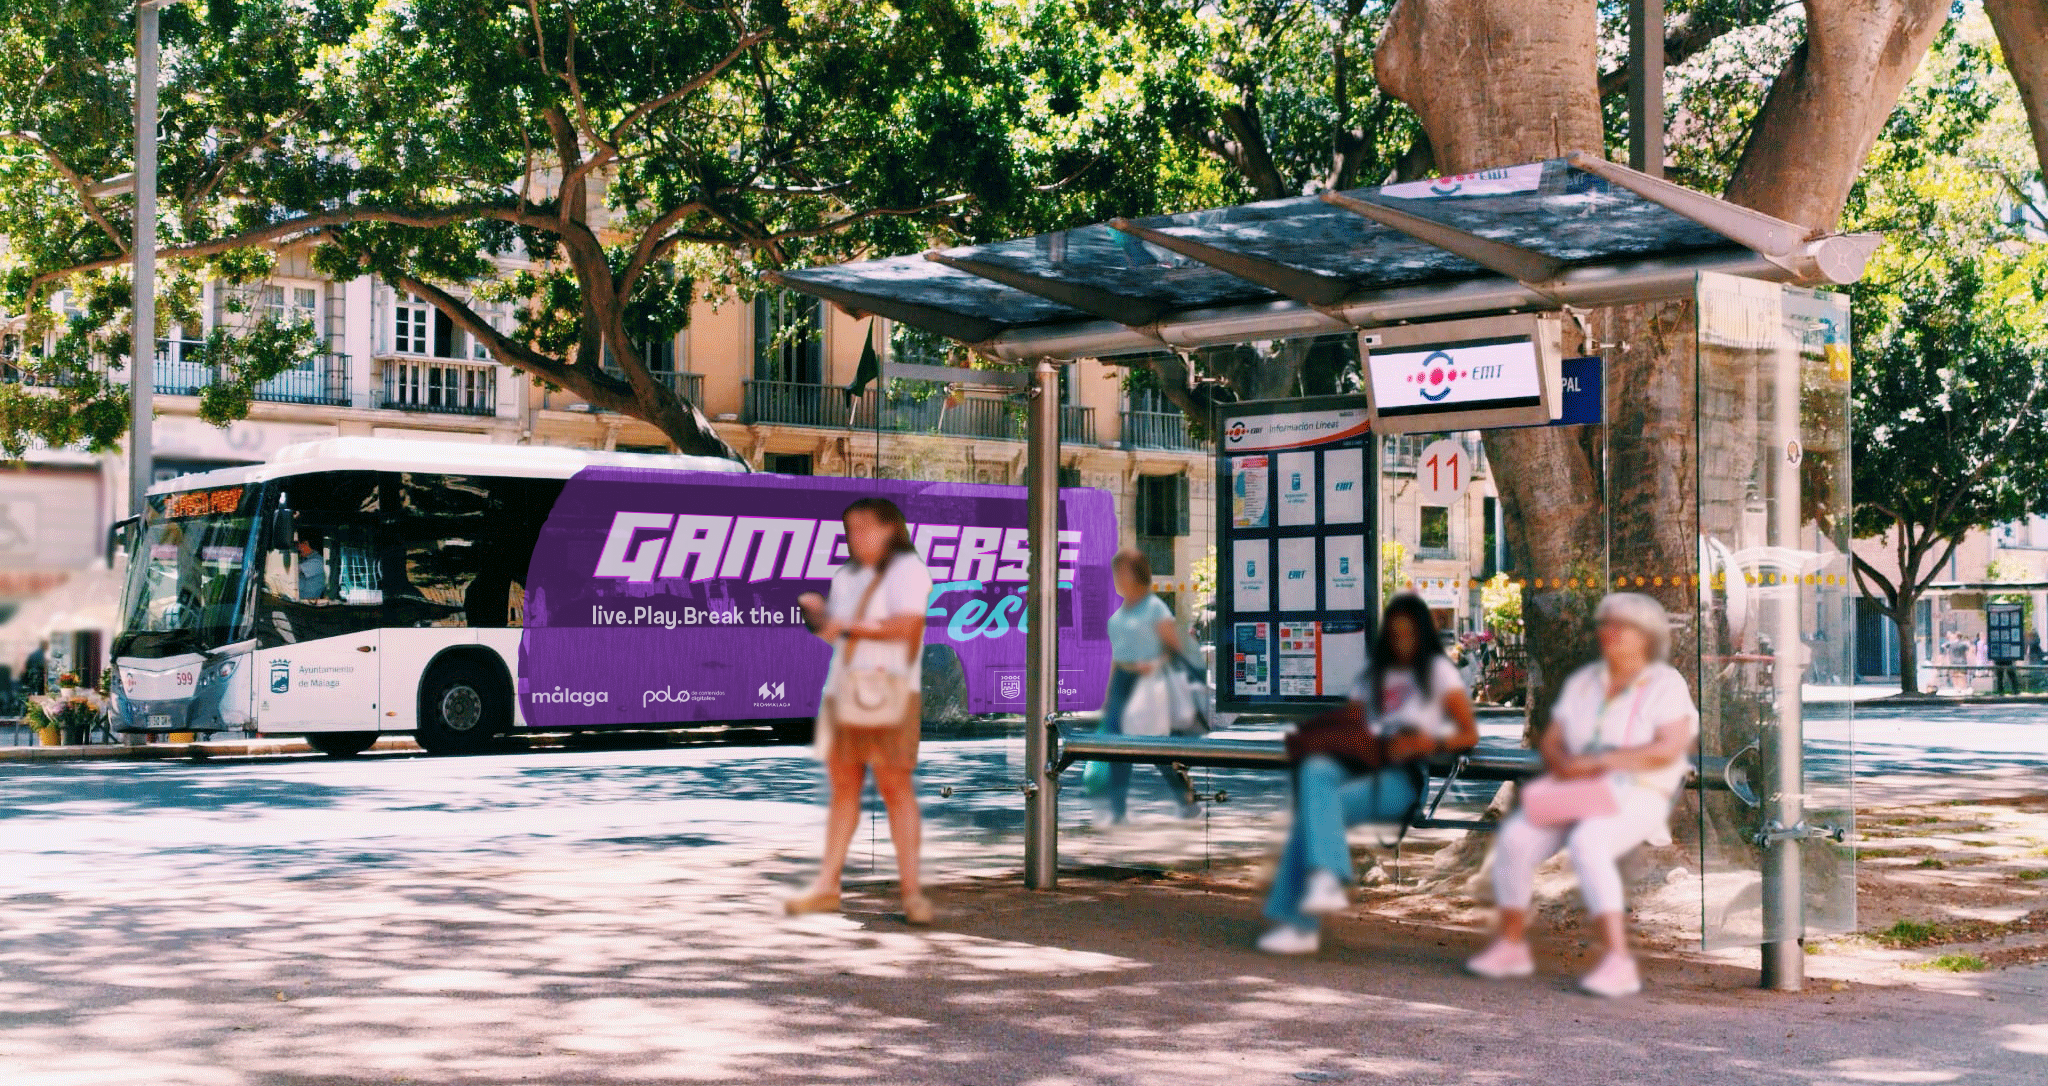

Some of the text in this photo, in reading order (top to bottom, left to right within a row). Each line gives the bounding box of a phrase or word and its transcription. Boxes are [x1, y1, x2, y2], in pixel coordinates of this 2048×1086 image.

[1472, 364, 1504, 381] EMT
[1426, 452, 1459, 492] 11
[749, 606, 784, 625] the
[176, 671, 193, 686] 599
[298, 665, 354, 676] Ayuntamiento
[298, 679, 309, 688] de
